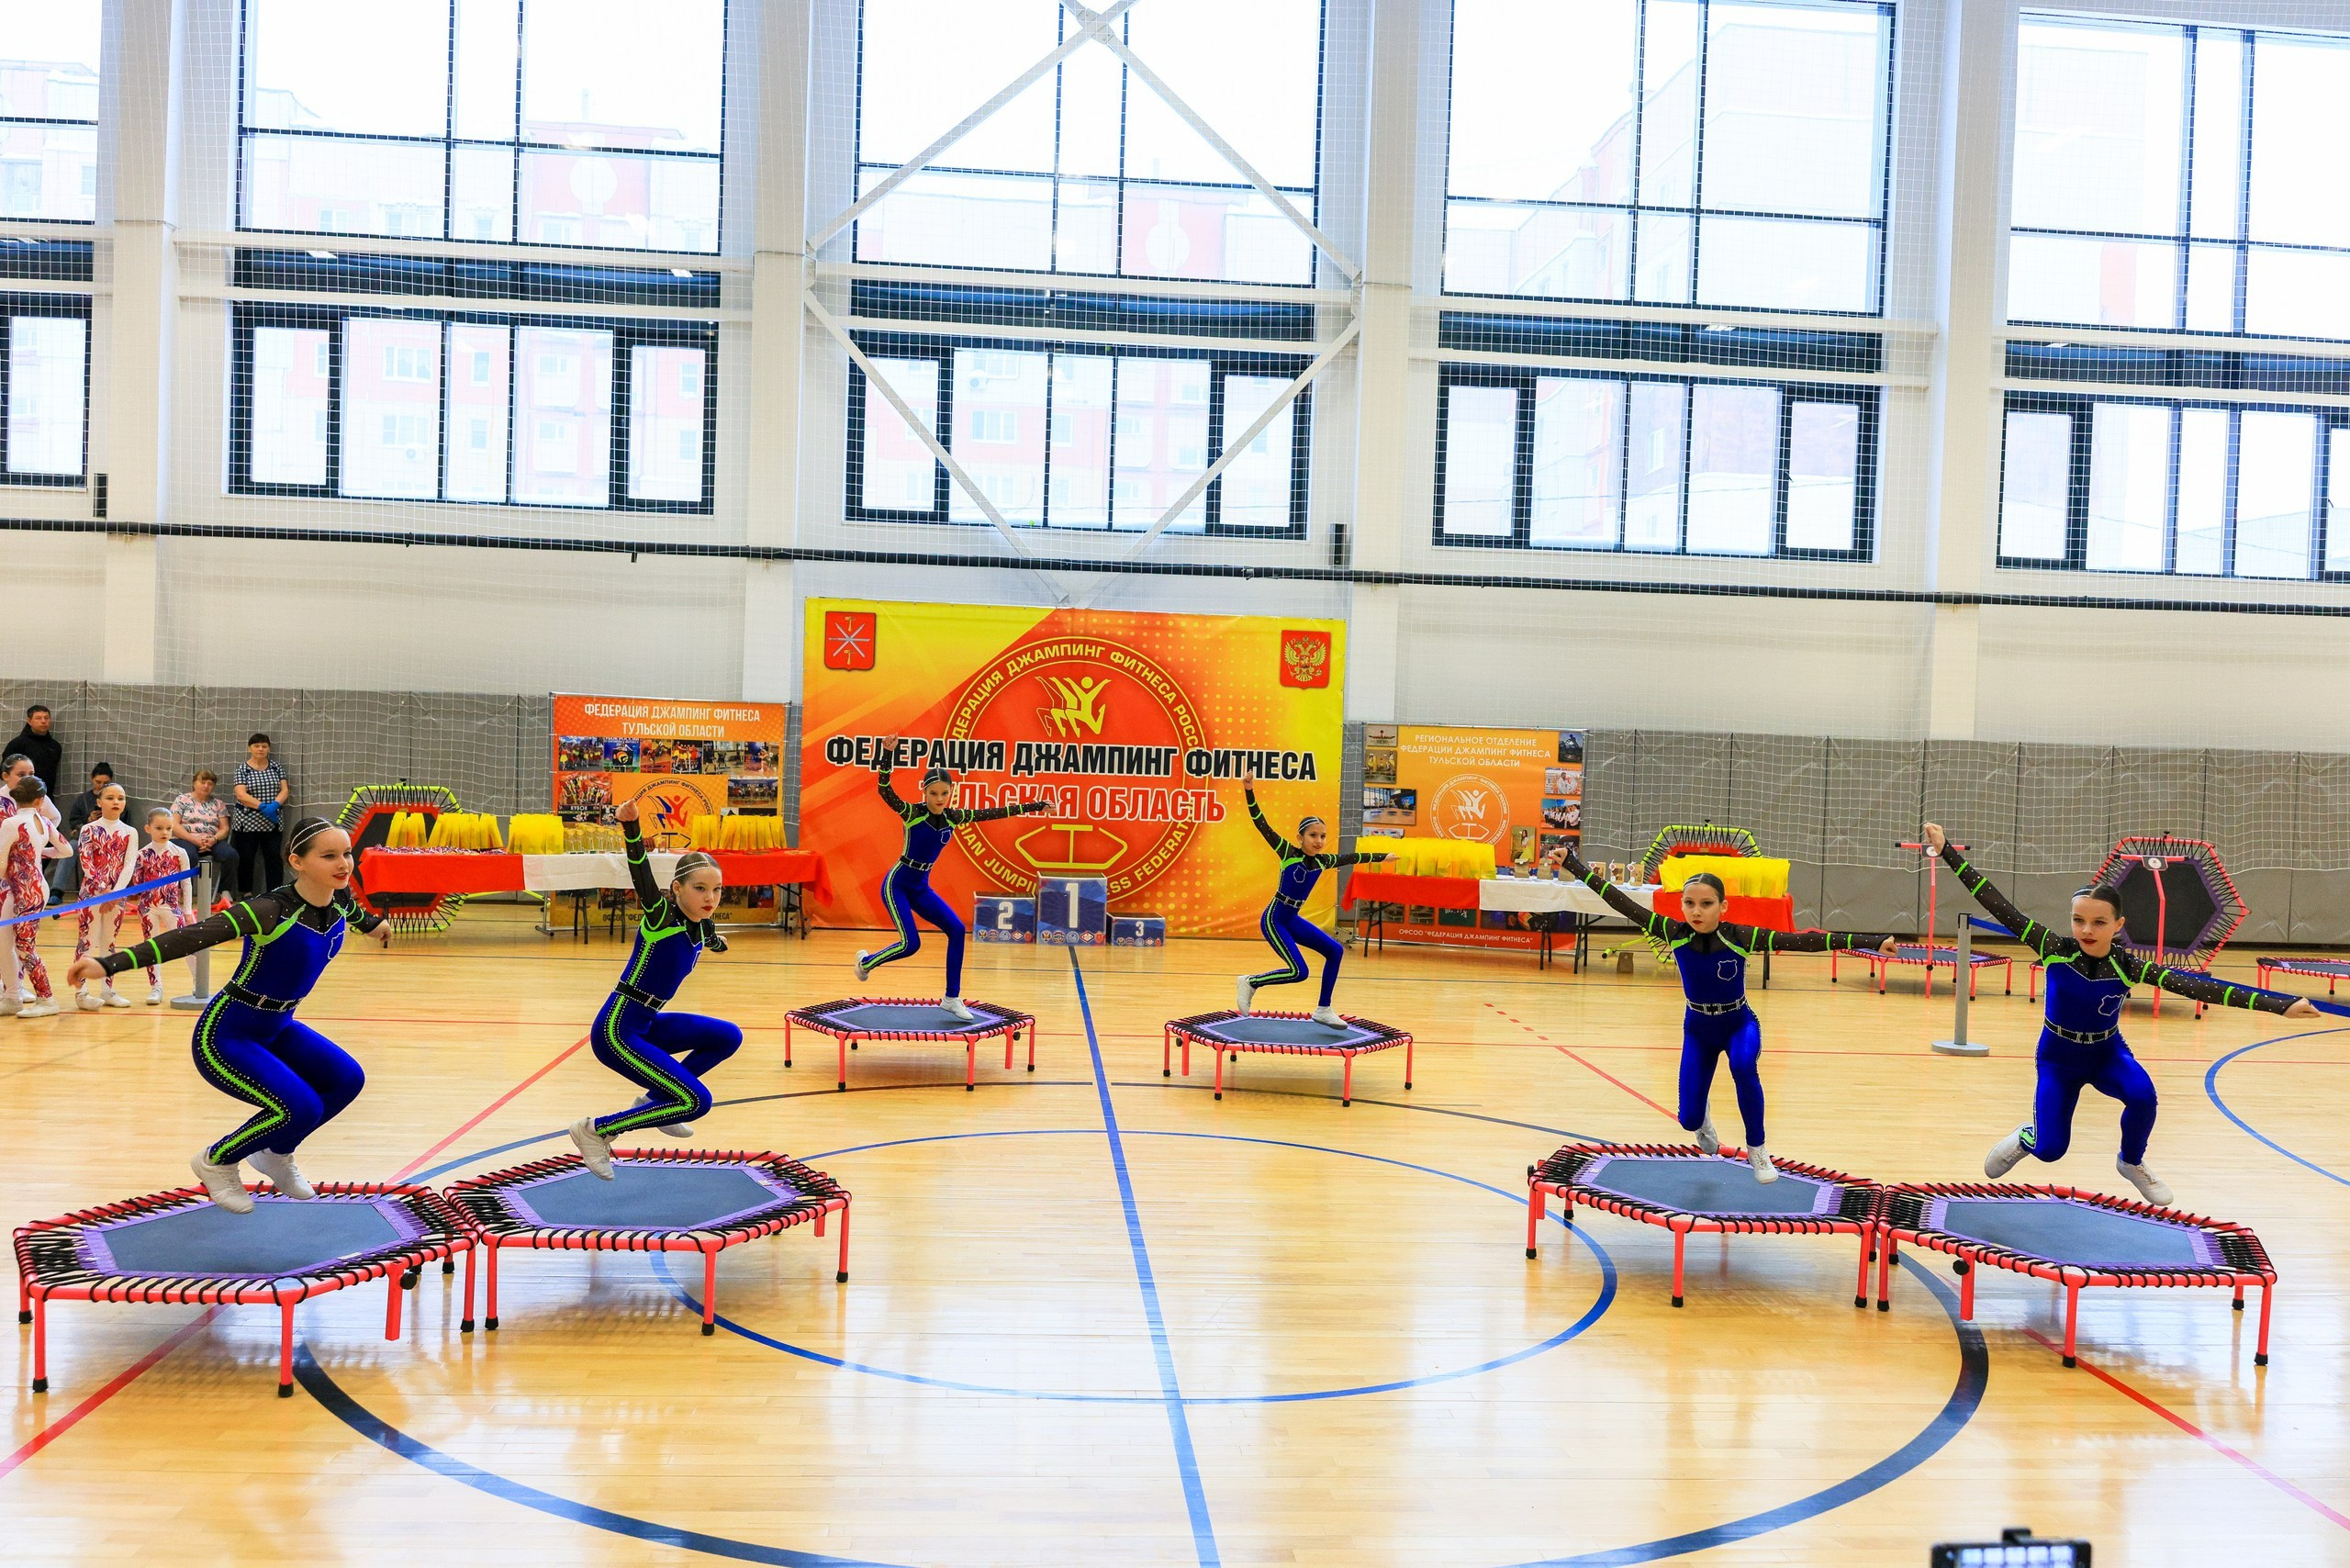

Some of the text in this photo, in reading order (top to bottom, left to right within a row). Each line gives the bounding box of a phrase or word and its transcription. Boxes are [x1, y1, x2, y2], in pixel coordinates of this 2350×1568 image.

[952, 644, 1200, 749] ДЕРАЦИЯ ДЖАМПИНГ ФИТНЕСА РОСС
[585, 703, 760, 722] ФЕДЕРАЦИЯ ДЖАМПИНГ ФИТНЕСА
[622, 722, 725, 738] ТУЛЬСКОЙ ОБЛАСТИ
[1415, 734, 1537, 746] РЕГИОНАЛЬНОЕ ОТДЕЛЕНИЕ
[1012, 741, 1179, 778] ДЖАМПИНГ
[1185, 747, 1317, 781] ФИТНЕСА
[1400, 745, 1550, 758] ФЕДЕРАЦИИ ДЖАМПИНГ ФИТНЕСА
[1429, 756, 1520, 767] ТУЛЬСКОЙ ОБЛАСТИ
[919, 780, 1226, 823] ЛЬСКАЯ ОБЛАСТЬ
[983, 857, 1037, 894] JUMPI
[1134, 820, 1191, 881] FEDERAT
[997, 901, 1013, 930] 2
[1065, 882, 1079, 929] 1
[1135, 921, 1145, 936] 3
